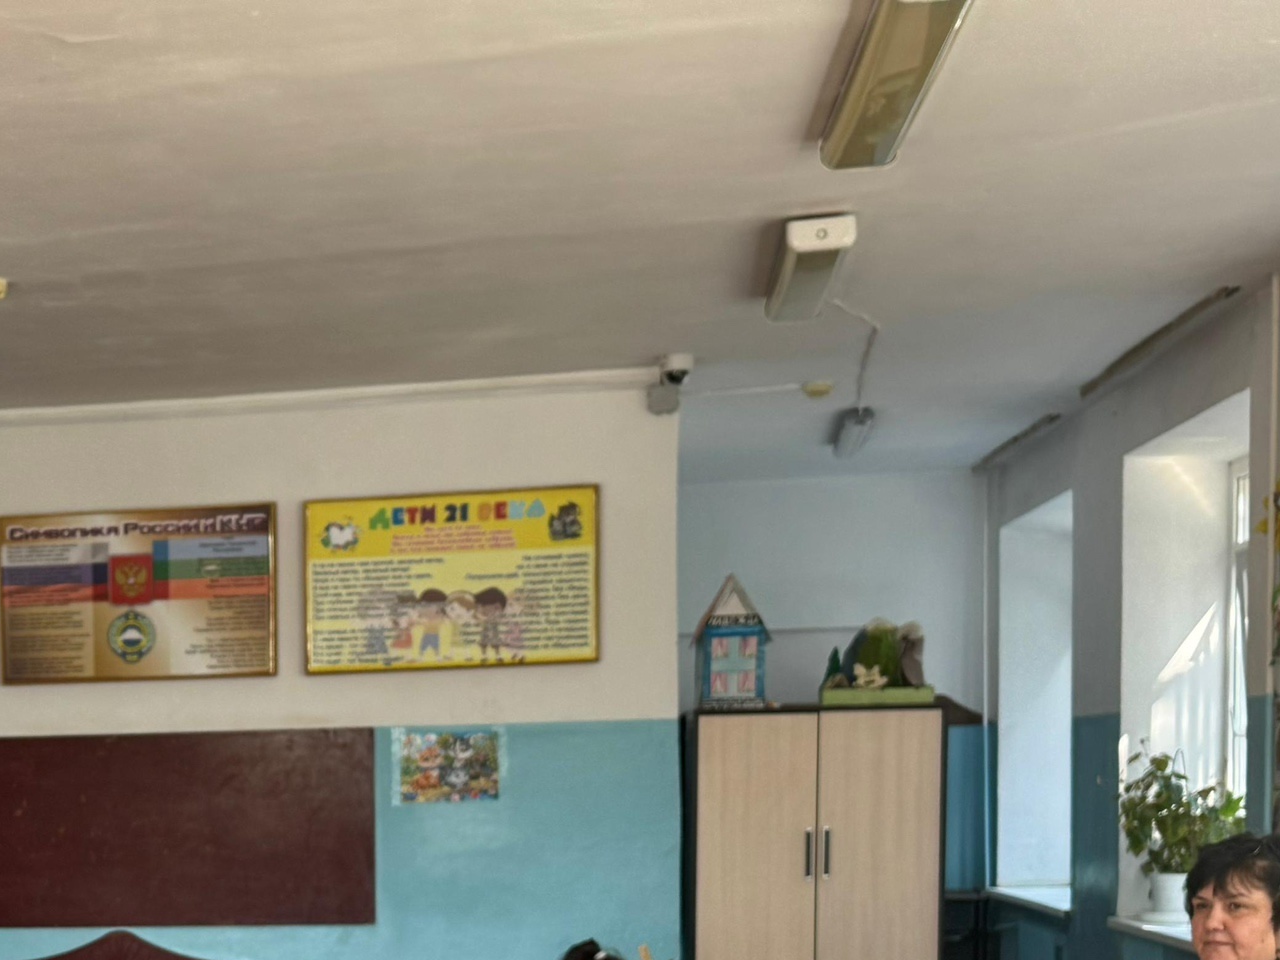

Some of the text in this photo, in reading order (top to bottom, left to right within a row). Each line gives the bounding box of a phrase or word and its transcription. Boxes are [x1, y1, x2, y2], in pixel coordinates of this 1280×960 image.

[369, 498, 546, 530] ДЕТИ 21 ВЕКА
